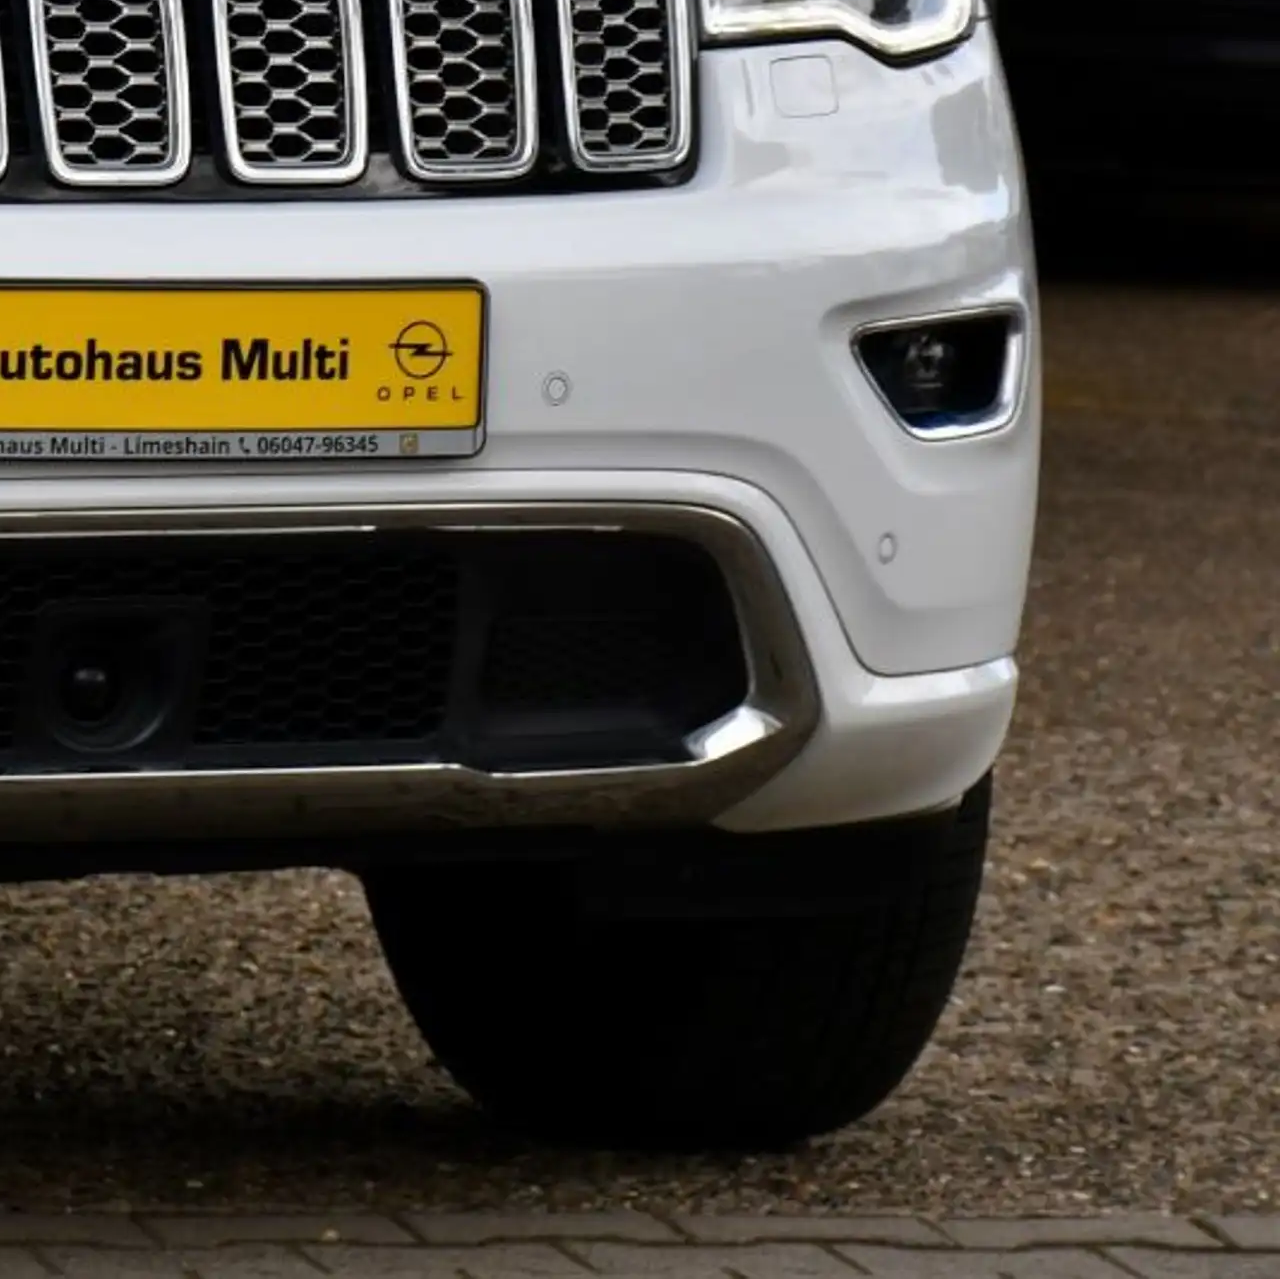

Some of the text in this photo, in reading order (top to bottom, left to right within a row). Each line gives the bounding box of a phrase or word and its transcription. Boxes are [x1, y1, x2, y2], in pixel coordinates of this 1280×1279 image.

[220, 337, 350, 381] Multi
[376, 385, 465, 402] OPEL
[50, 435, 106, 455] Multi
[123, 435, 231, 456] Limeshain
[256, 434, 379, 455] 06047-96345
